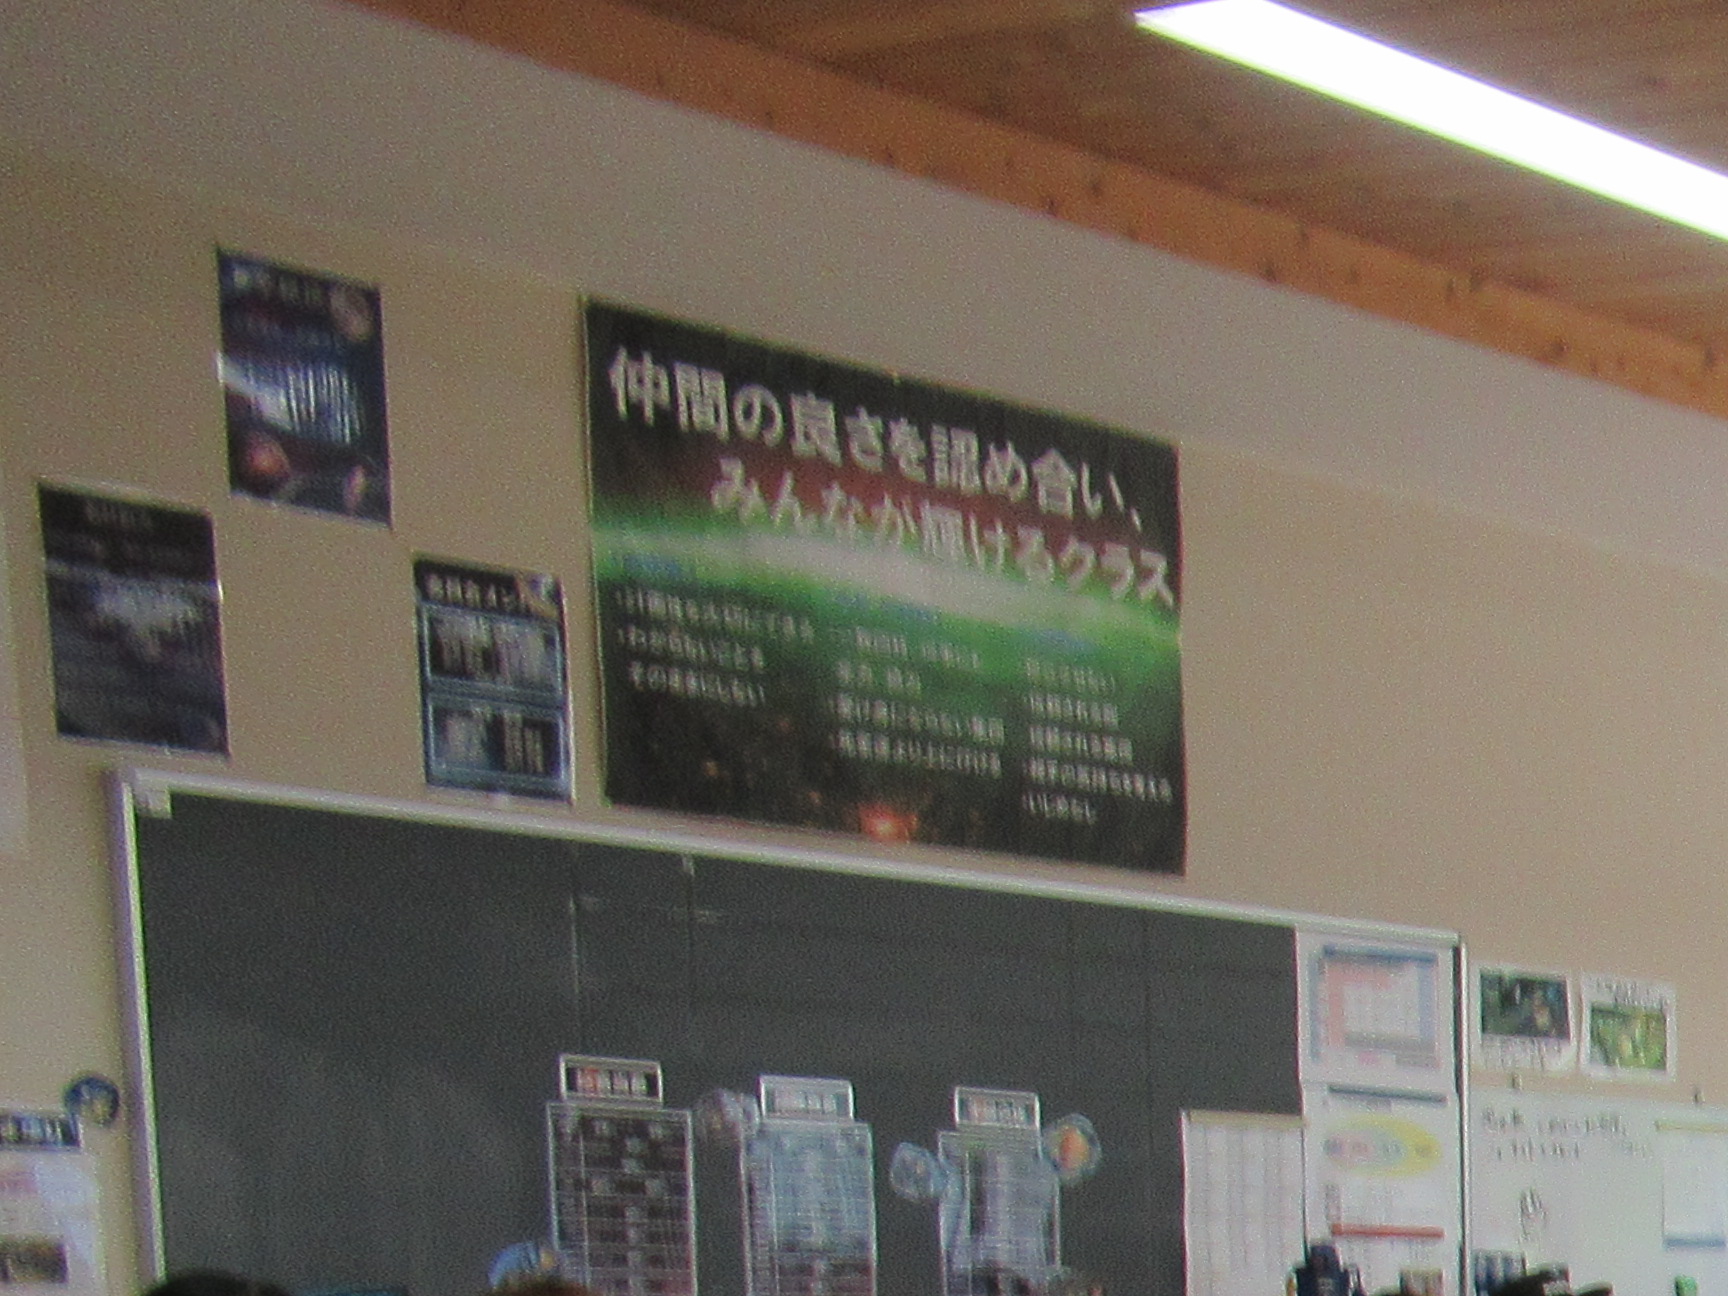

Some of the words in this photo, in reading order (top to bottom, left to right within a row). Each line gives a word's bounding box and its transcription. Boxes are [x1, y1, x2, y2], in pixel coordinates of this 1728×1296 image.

[607, 346, 1143, 533] 仲間の良さを認め合い、
[709, 456, 1174, 608] みんなが輝けるクラス
